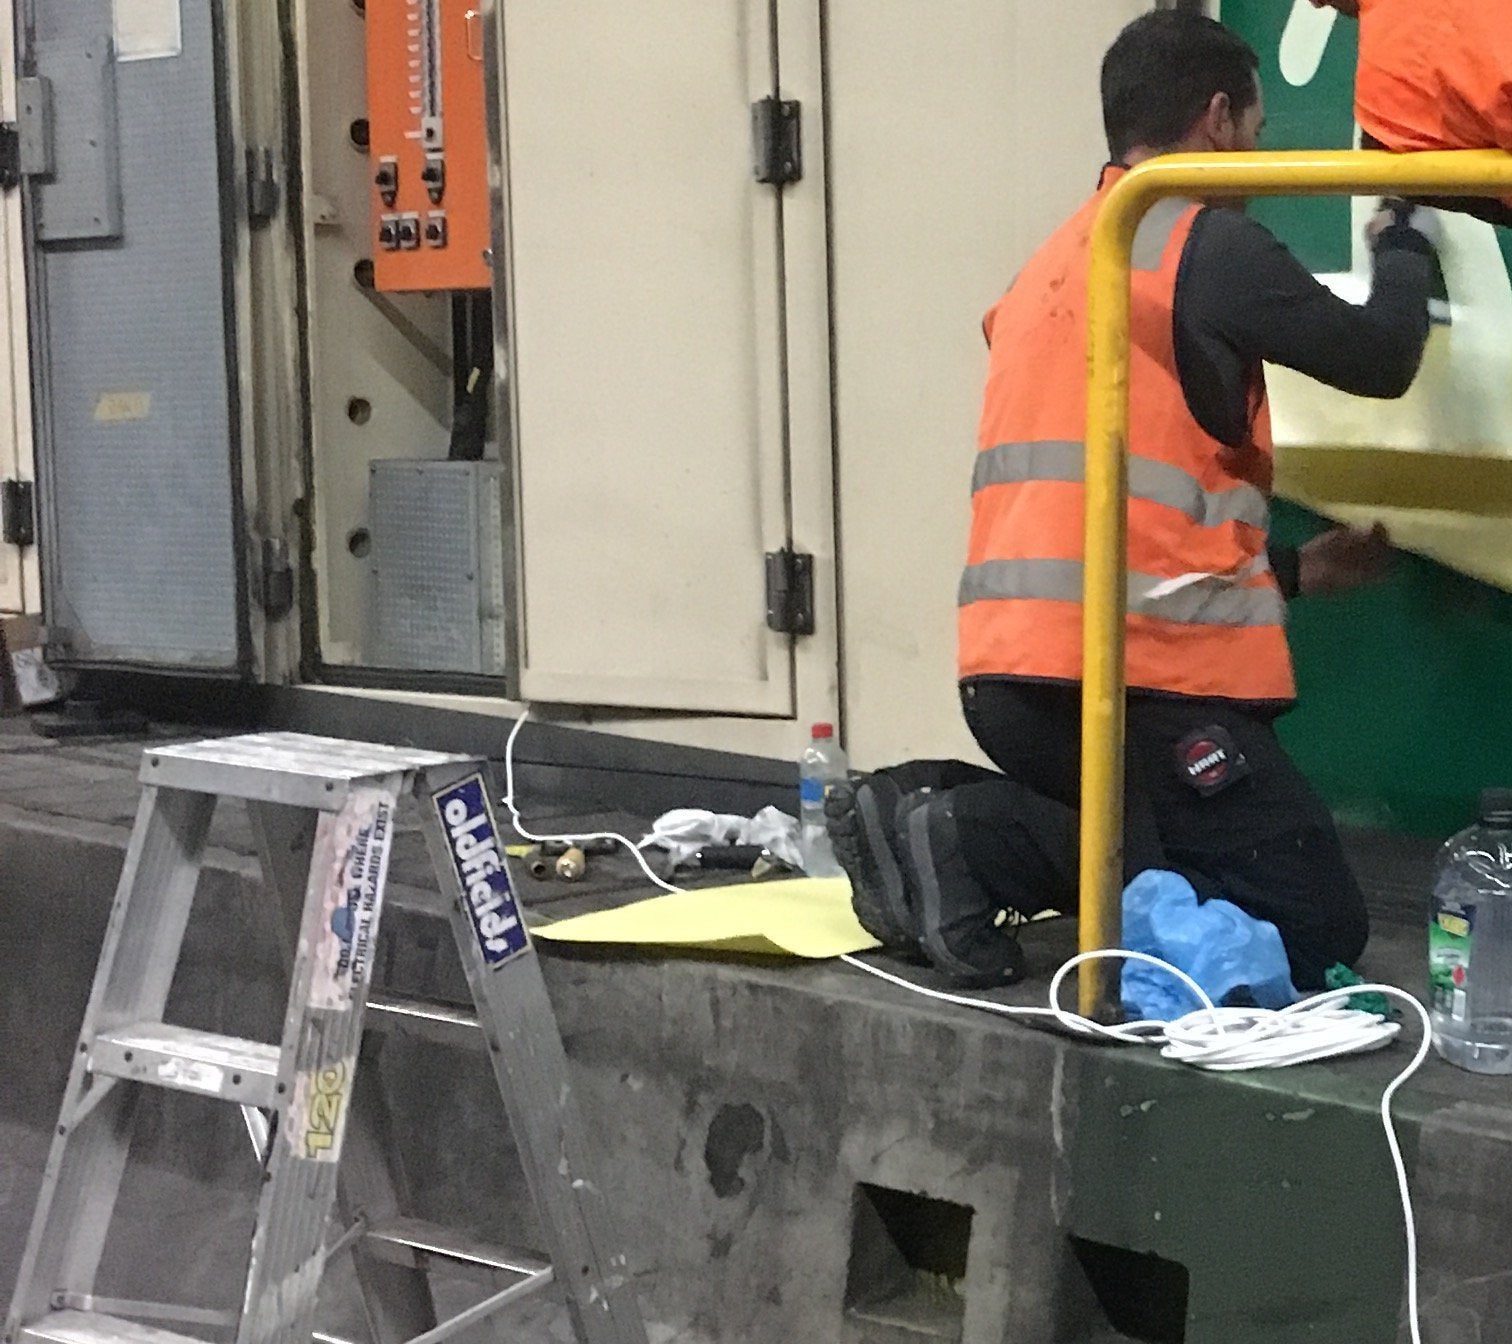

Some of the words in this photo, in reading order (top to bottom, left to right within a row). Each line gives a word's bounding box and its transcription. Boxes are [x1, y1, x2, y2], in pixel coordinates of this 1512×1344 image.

[373, 801, 391, 841] EXIST
[445, 797, 519, 953] oldfields
[305, 1060, 346, 1158] 120
